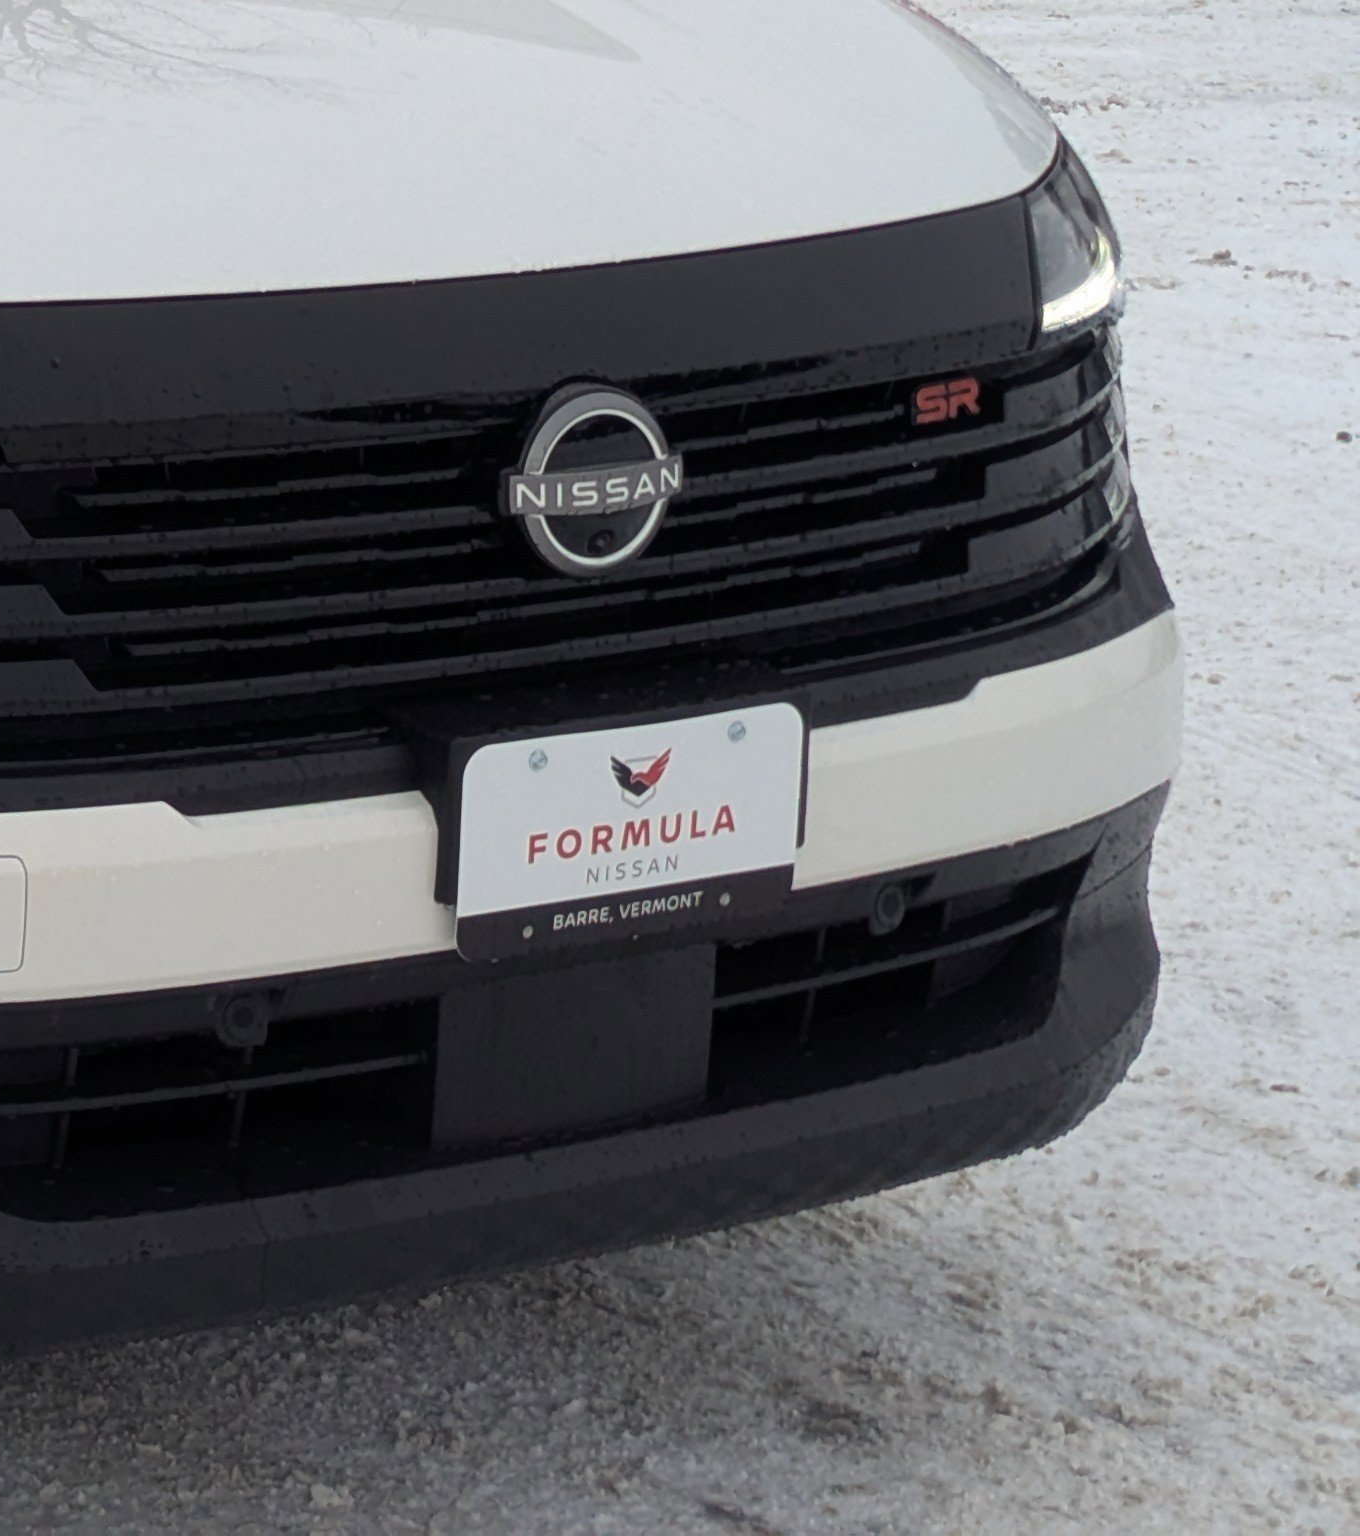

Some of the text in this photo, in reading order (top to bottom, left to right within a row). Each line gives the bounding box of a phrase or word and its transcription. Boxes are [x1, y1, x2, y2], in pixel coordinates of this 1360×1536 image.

[914, 376, 981, 425] SR
[515, 462, 681, 510] NISSAN
[527, 804, 736, 864] FORMULA
[585, 855, 679, 885] NISSAN
[552, 891, 703, 931] BARRE, VERMONT
